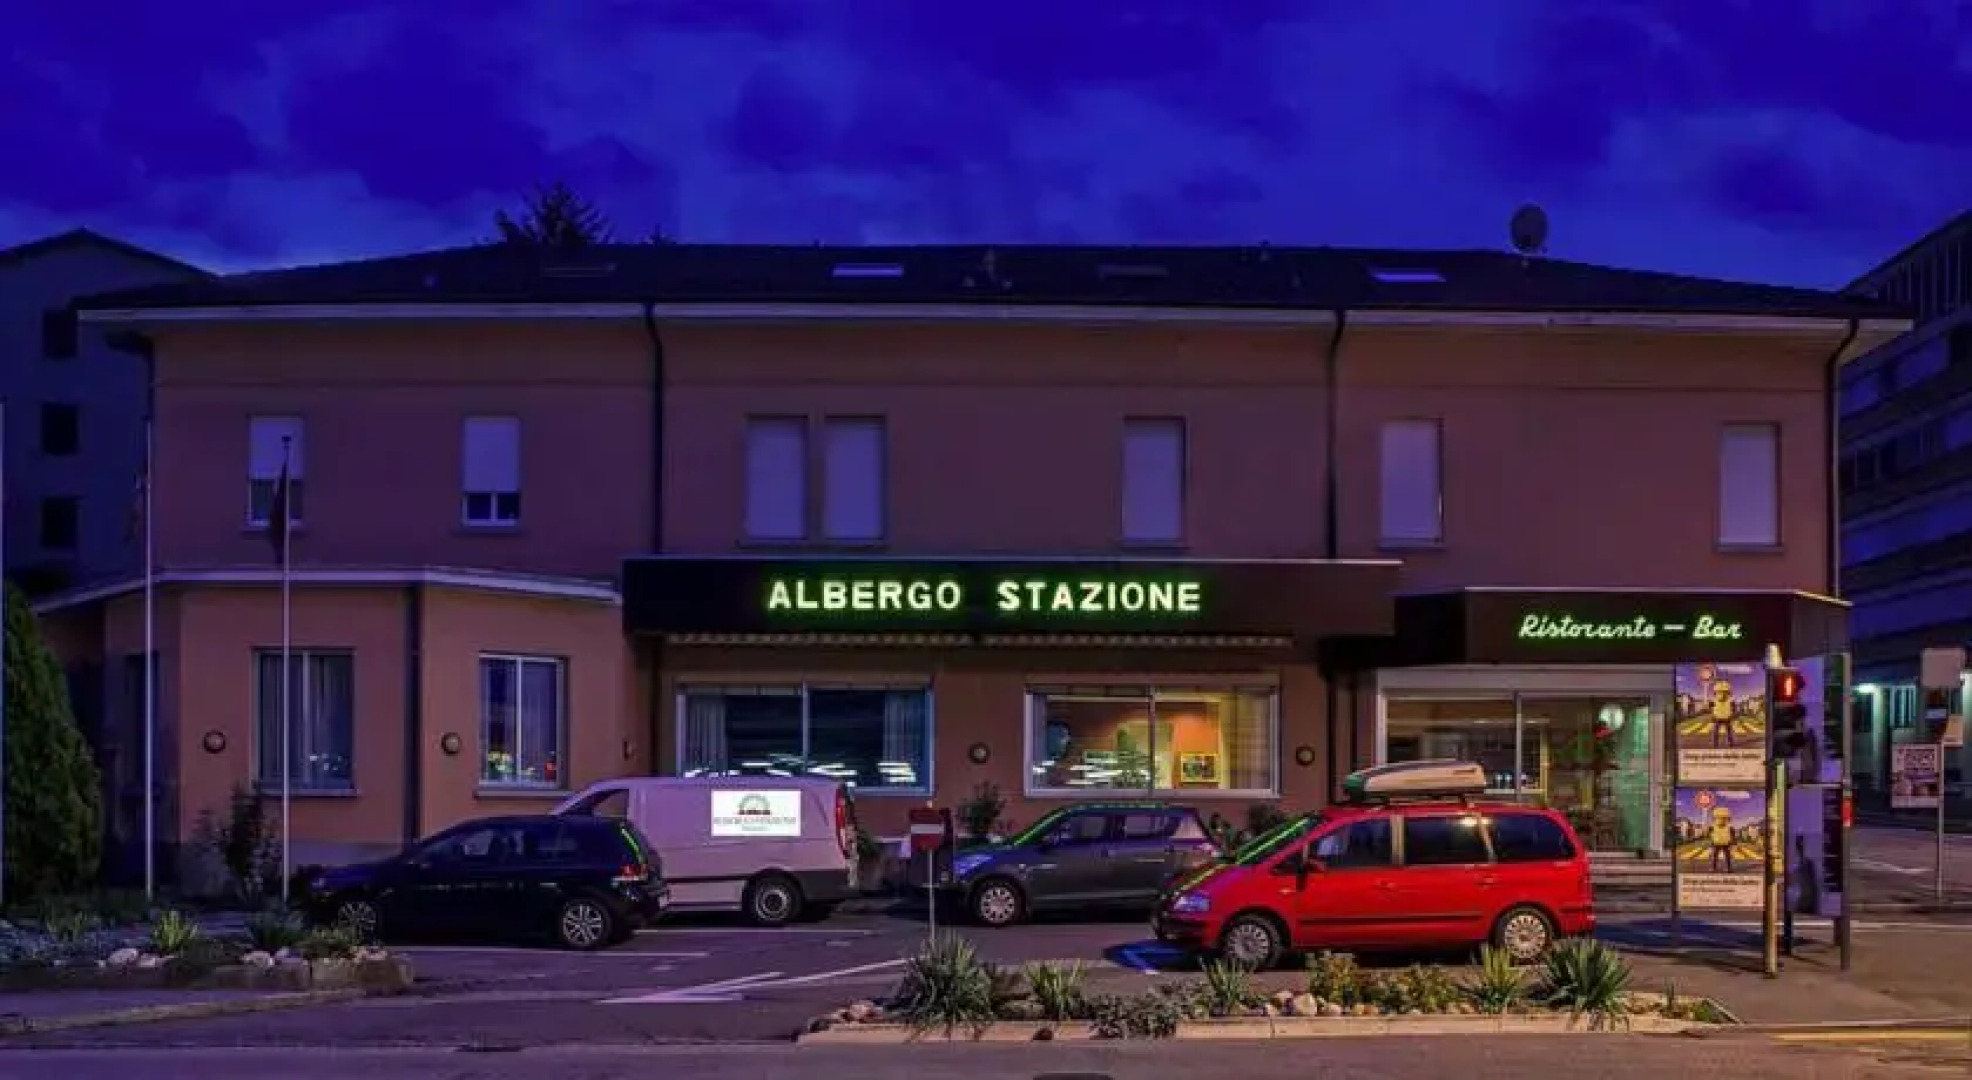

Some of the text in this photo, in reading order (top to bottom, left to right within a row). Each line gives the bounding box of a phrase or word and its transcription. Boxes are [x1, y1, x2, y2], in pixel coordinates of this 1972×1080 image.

[768, 580, 1201, 611] ALBERGO STAZIONE
[1519, 614, 1656, 639] Ristorante
[1692, 614, 1743, 639] Bar
